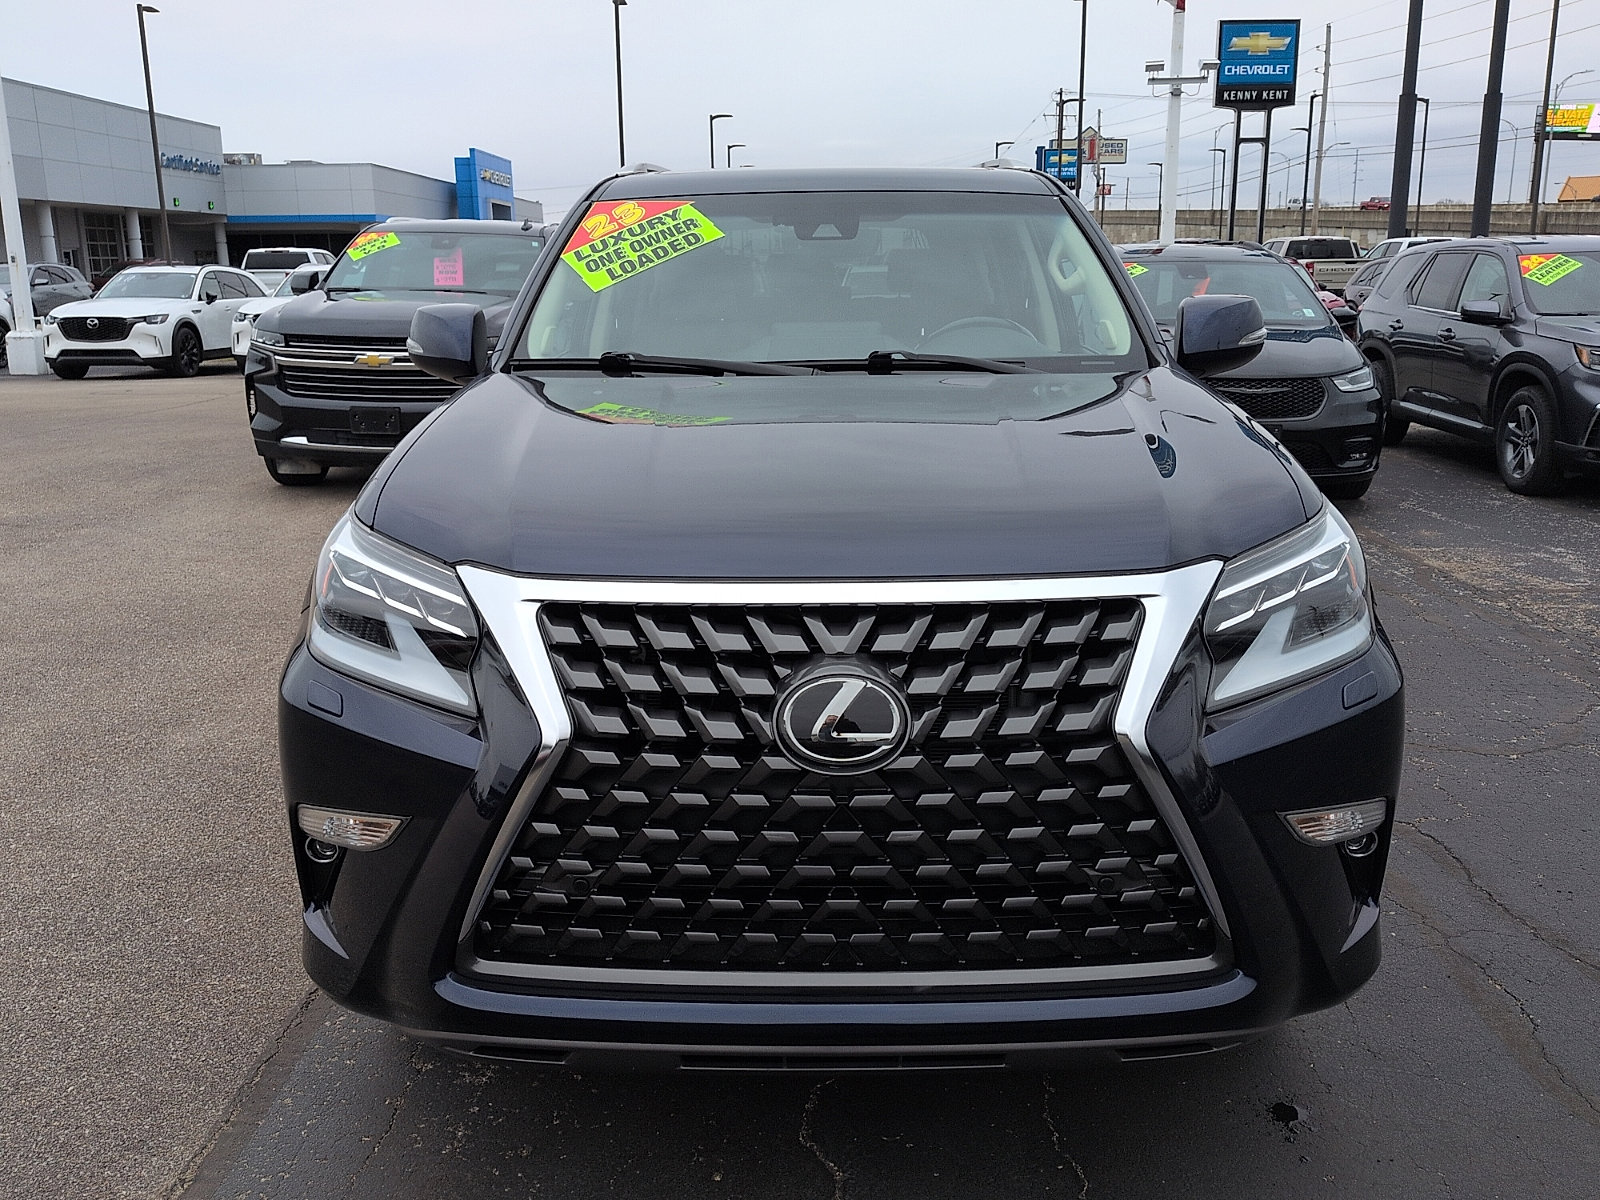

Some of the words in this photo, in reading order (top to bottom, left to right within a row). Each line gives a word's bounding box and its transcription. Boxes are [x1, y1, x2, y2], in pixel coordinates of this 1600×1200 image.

[1225, 65, 1290, 75] CHEVROLET
[1223, 90, 1257, 100] KENNY
[1262, 90, 1289, 100] KENT
[573, 208, 682, 263] LUXURY
[582, 201, 646, 240] 23
[584, 247, 627, 274] ONE
[629, 217, 702, 254] OWNER
[606, 232, 704, 281] LOADED
[1535, 259, 1570, 281] LEATHER
